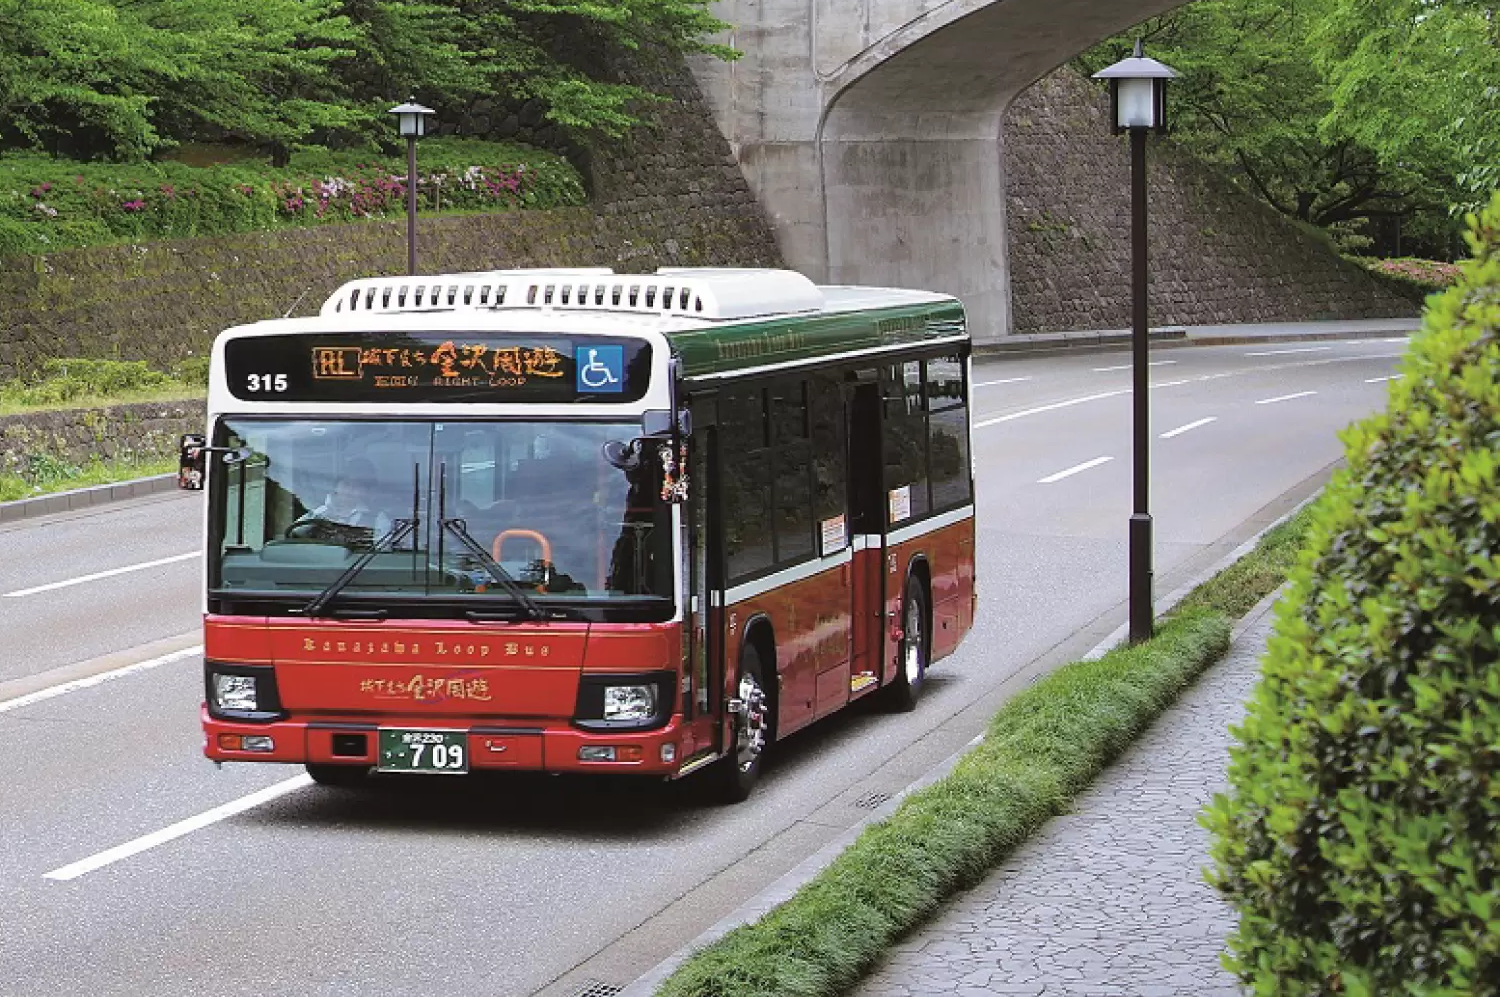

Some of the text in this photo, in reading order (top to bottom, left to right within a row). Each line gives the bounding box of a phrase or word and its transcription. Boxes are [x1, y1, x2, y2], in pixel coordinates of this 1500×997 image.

[319, 350, 355, 375] RL
[246, 373, 288, 391] 315
[433, 375, 480, 387] RIGHT
[488, 375, 528, 386] LOOP
[434, 642, 490, 656] Loop
